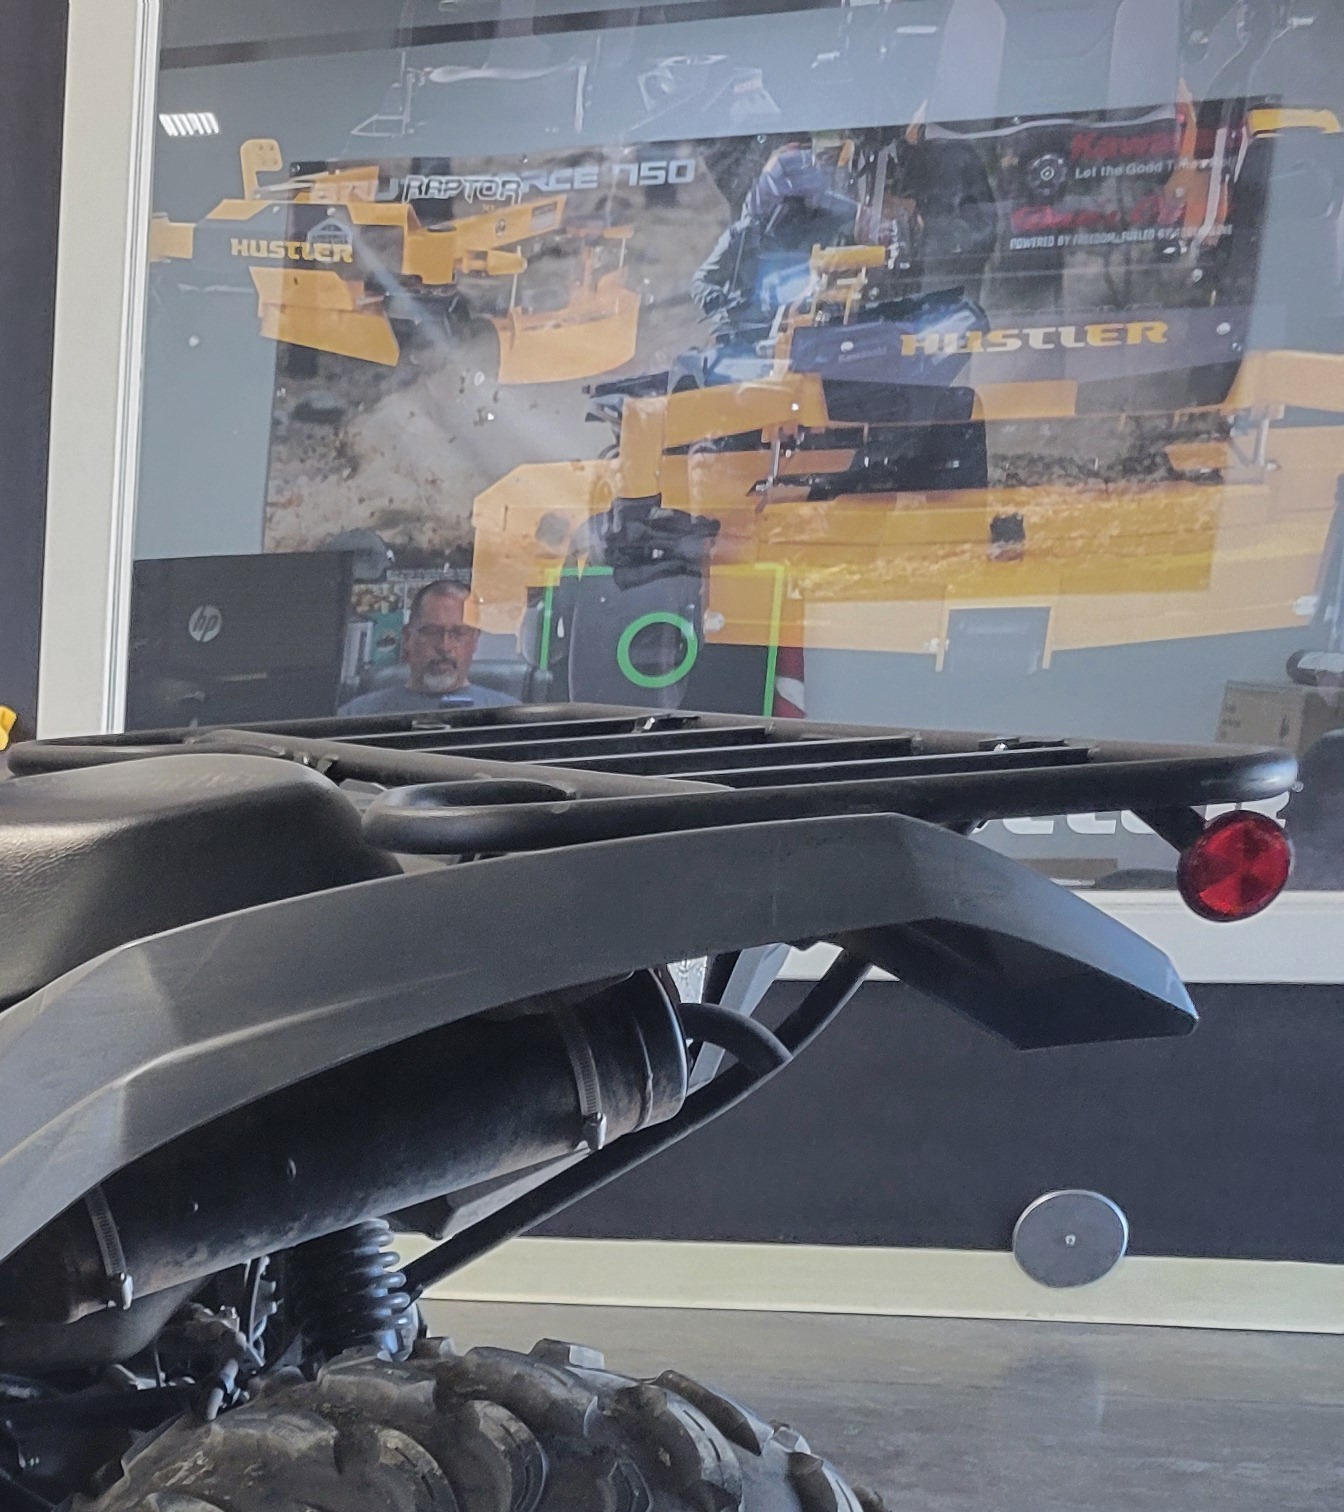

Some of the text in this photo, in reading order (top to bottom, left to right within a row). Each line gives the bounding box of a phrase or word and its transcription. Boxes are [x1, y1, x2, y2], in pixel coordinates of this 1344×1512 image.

[612, 158, 697, 187] 750
[229, 237, 354, 265] HUSTLER
[898, 320, 1169, 357] HUSTLER
